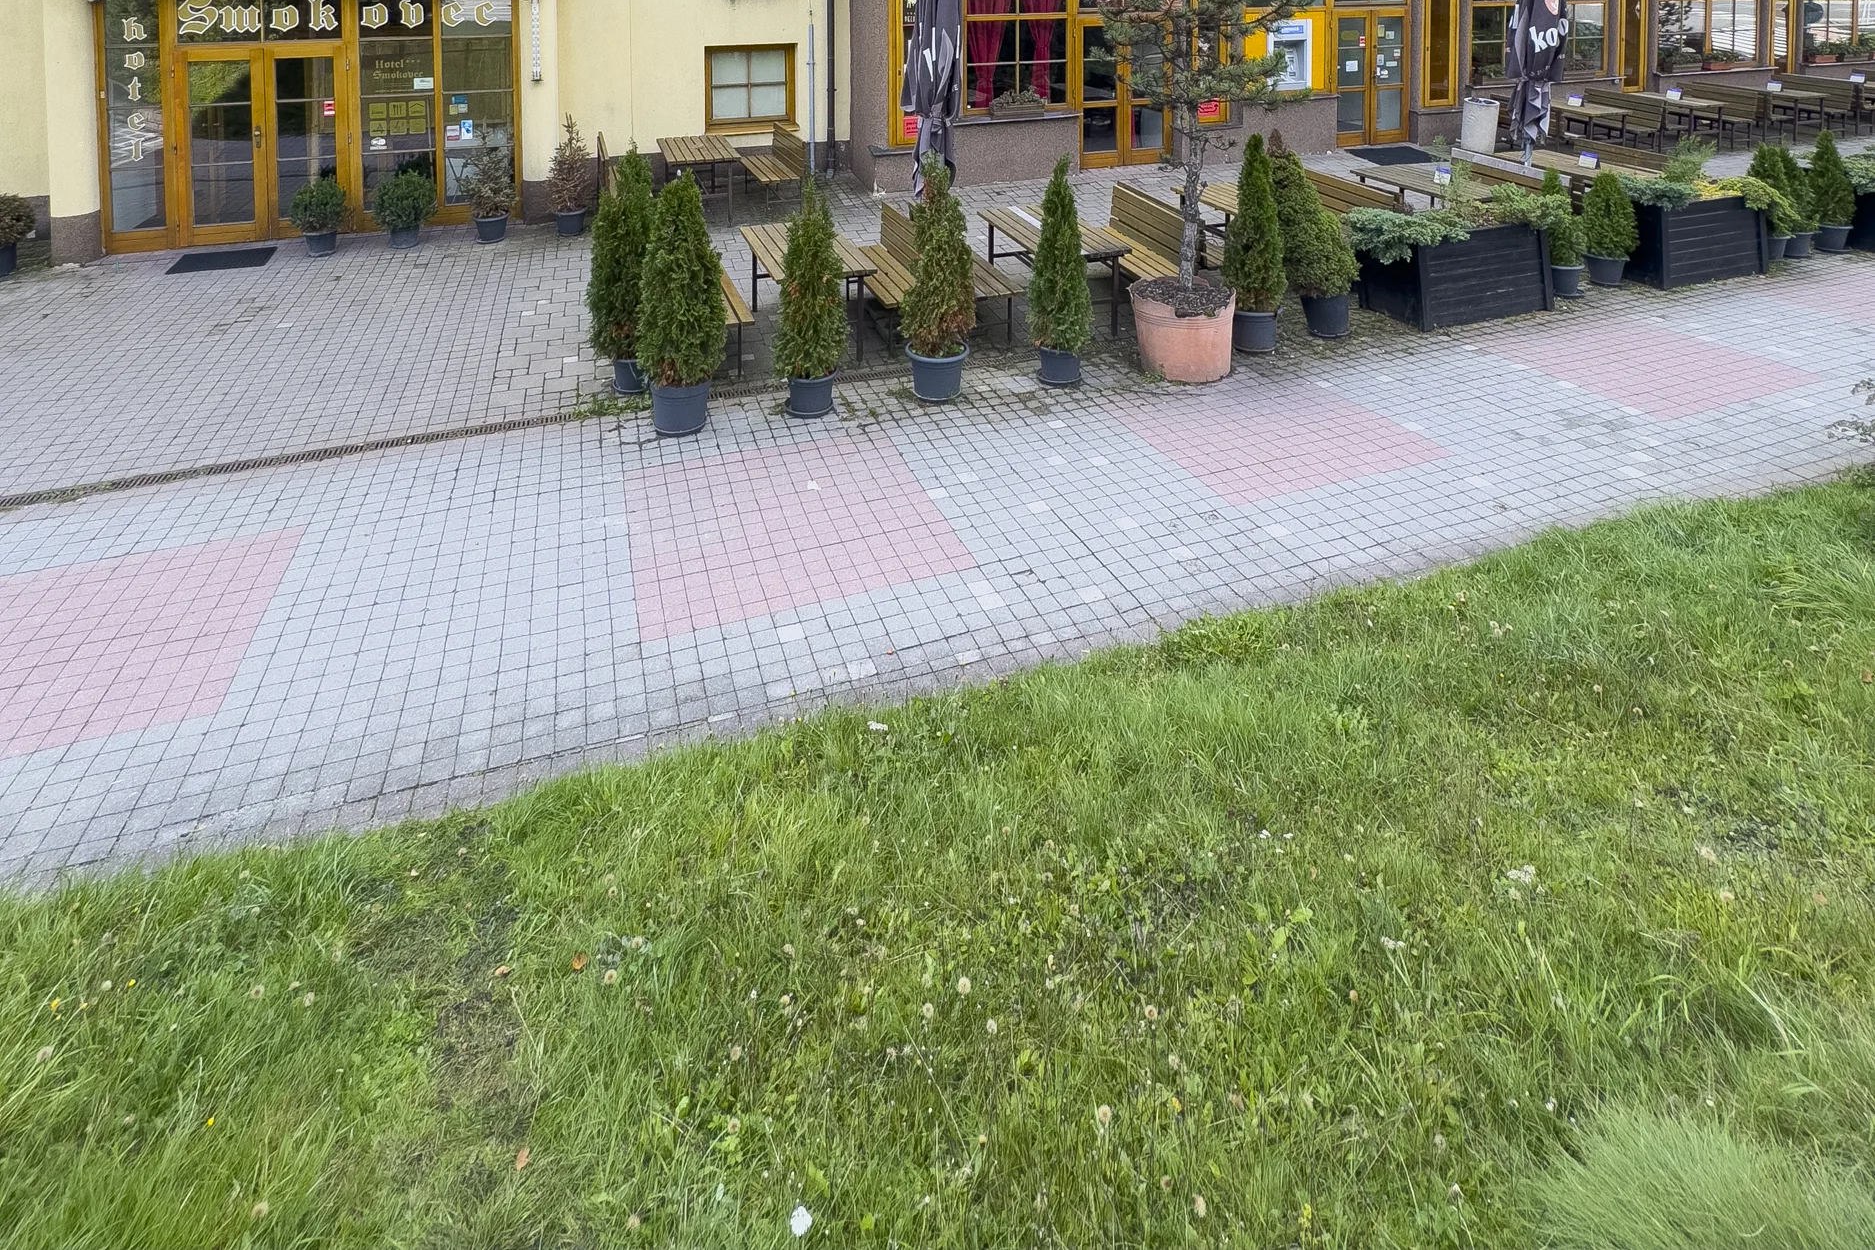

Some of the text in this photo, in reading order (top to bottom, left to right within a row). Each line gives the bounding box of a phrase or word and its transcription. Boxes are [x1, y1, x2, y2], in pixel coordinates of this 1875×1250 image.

[375, 59, 404, 69] Hotel
[372, 70, 424, 79] Smokovec
[122, 17, 147, 162] hotel
